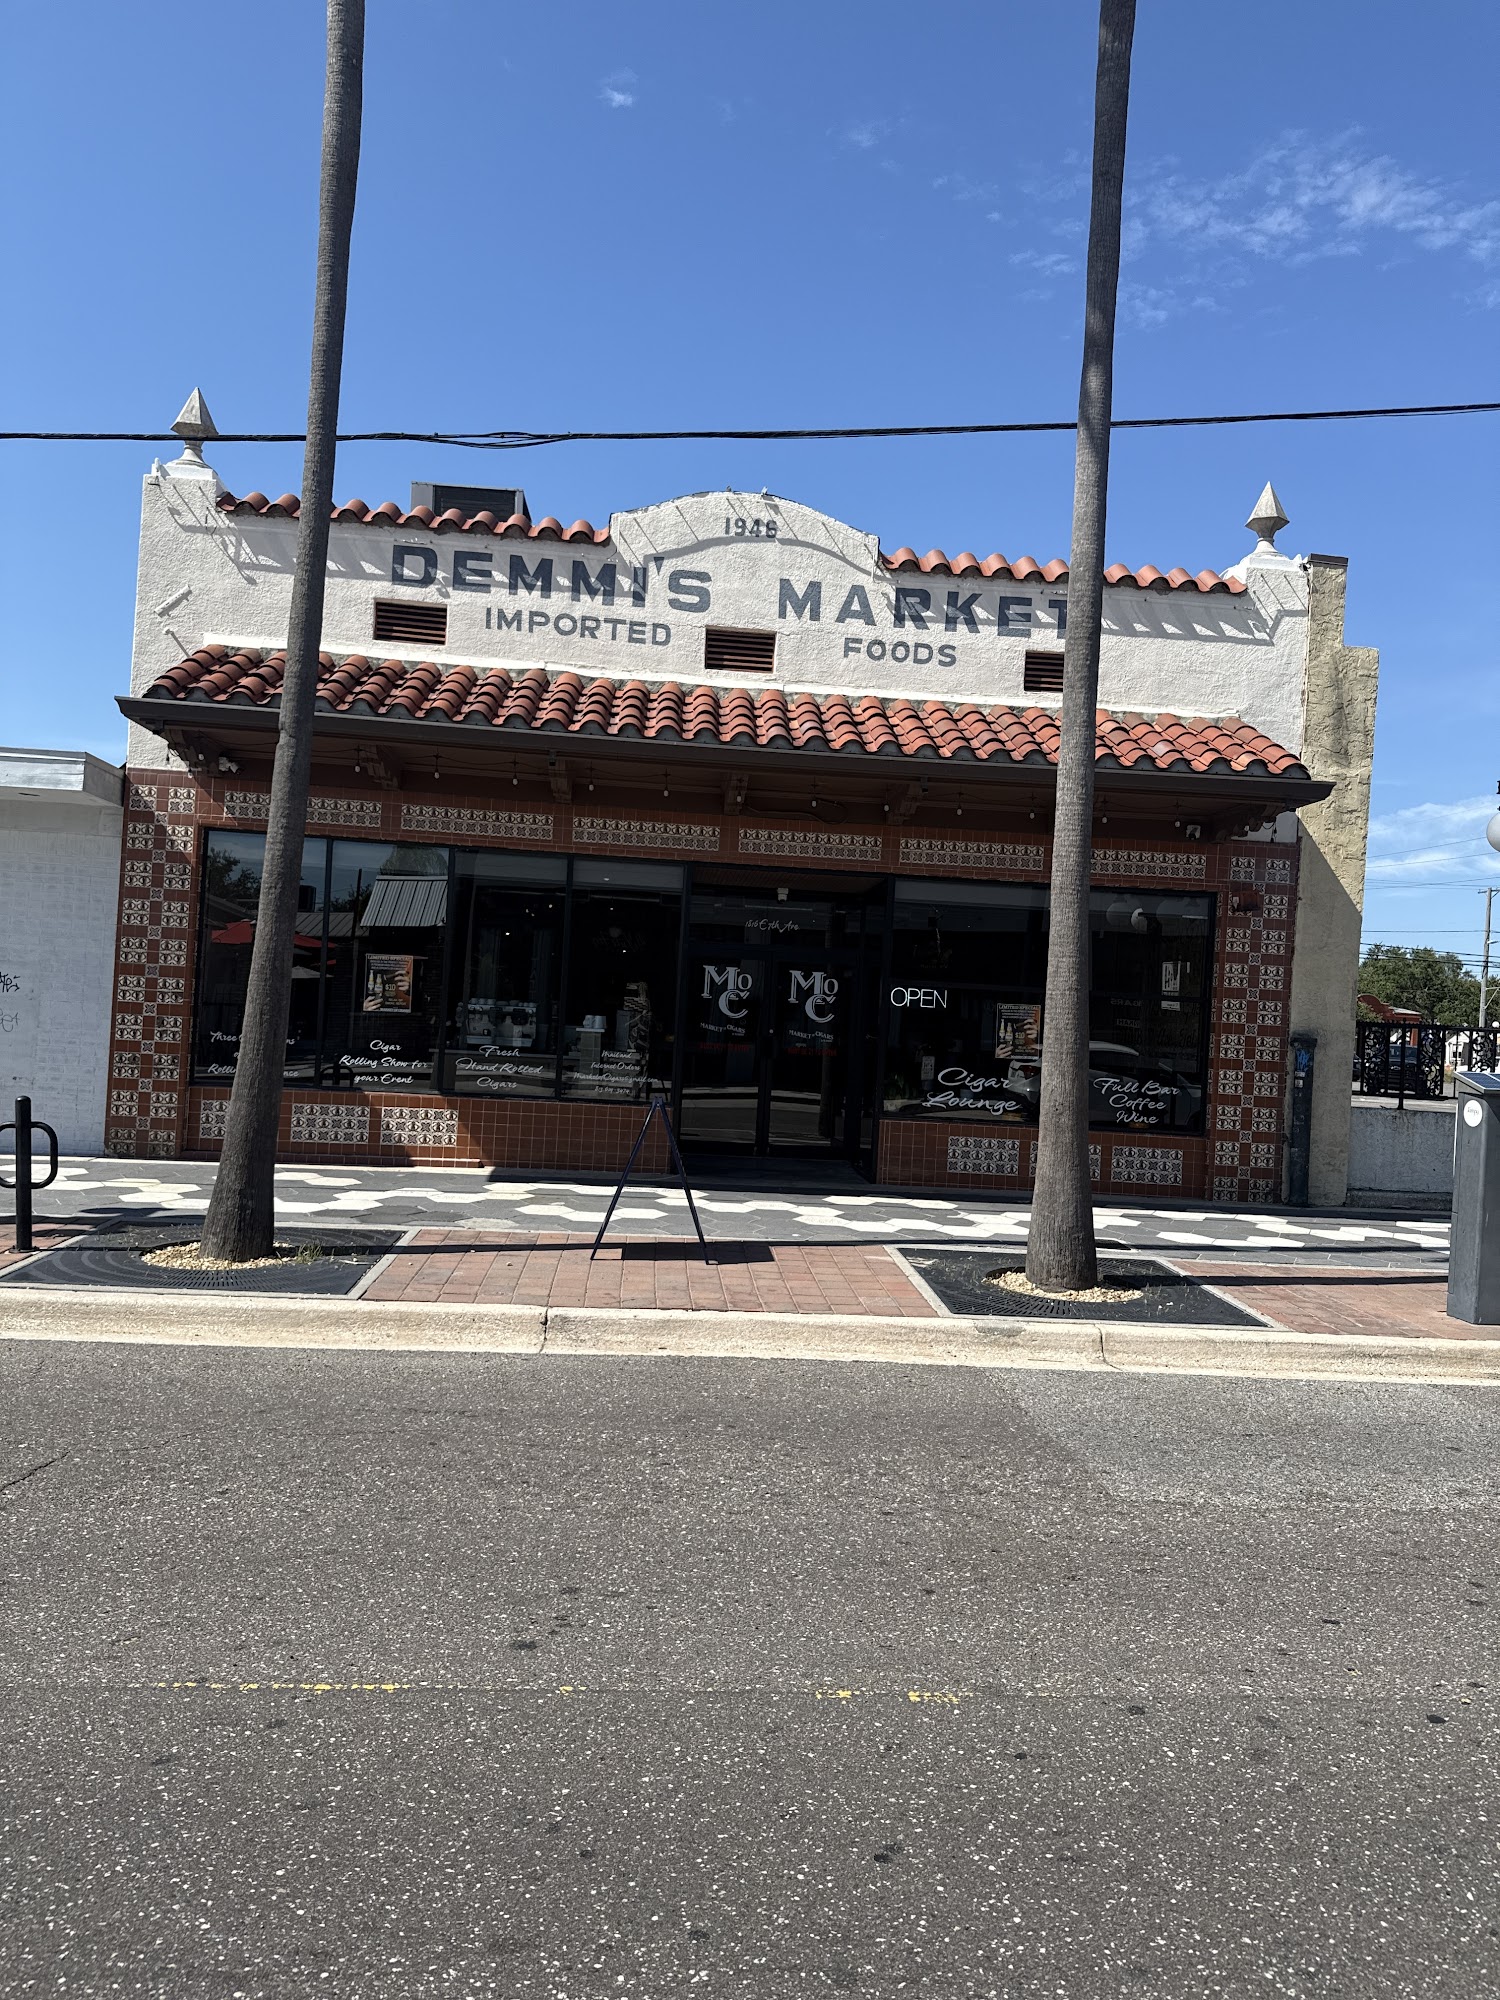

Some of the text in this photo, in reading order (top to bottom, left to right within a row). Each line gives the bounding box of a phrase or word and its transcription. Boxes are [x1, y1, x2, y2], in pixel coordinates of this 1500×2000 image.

[725, 516, 777, 538] 1946
[392, 544, 1068, 640] DEMMI'S MARKET
[485, 607, 672, 647] IMPORTED
[843, 637, 957, 667] FOODS
[384, 983, 396, 991] $10
[890, 986, 947, 1009] OPEN
[210, 1030, 238, 1043] Three
[369, 1039, 402, 1053] Cigar
[478, 1045, 521, 1057] Fresh
[338, 1054, 428, 1069] Rolling Show for
[455, 1057, 544, 1074] Hand Rolled
[353, 1073, 414, 1084] your Event
[476, 1076, 517, 1090] Cigars
[937, 1067, 1013, 1092] Cigar
[1093, 1078, 1180, 1095] Full Bar
[922, 1090, 1021, 1115] Lounge
[1109, 1093, 1167, 1111] Coffee
[1116, 1110, 1160, 1123] Wine
